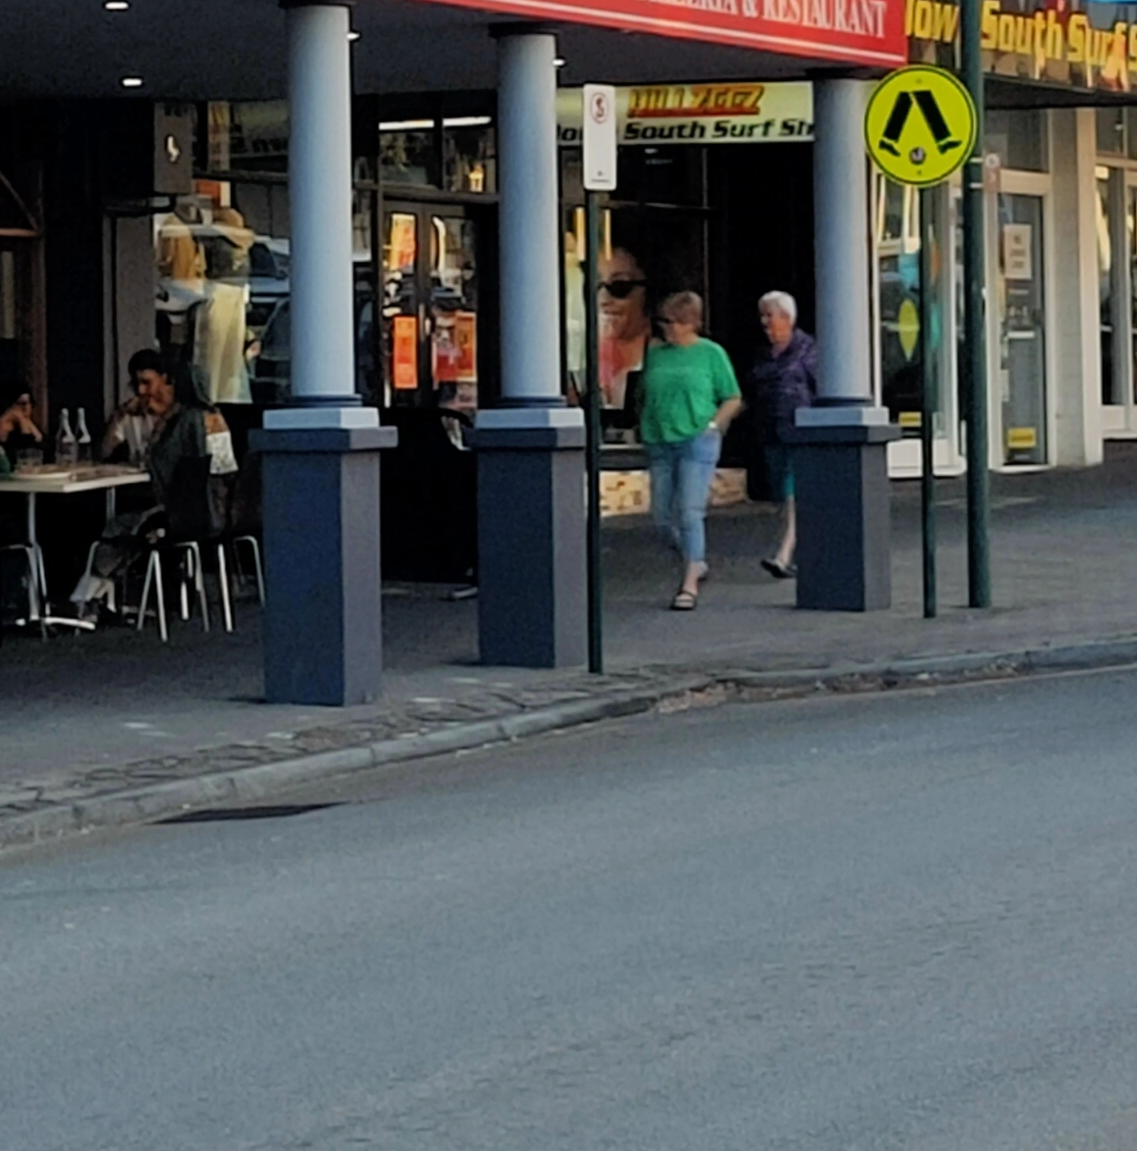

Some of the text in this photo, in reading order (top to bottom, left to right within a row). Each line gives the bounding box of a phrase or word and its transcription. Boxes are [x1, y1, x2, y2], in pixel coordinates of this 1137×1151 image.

[1066, 13, 1127, 67] Surf
[623, 120, 706, 141] South
[711, 119, 772, 140] Surf
[779, 117, 815, 137] Sh
